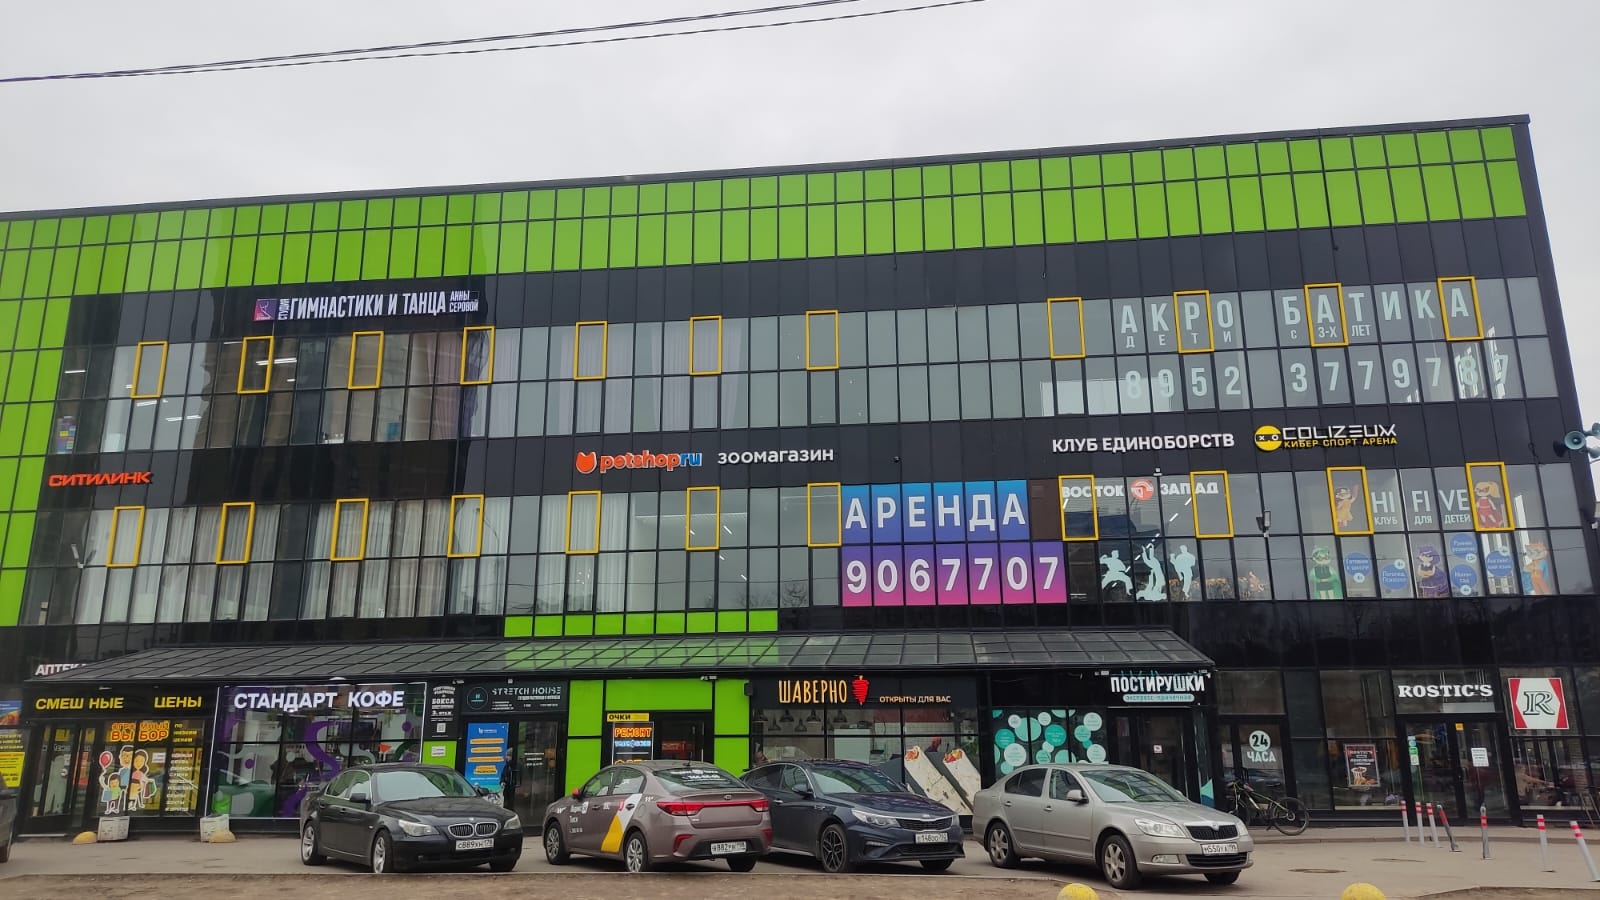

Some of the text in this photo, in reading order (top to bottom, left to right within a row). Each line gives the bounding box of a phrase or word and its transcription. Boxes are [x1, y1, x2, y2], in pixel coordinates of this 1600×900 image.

[450, 290, 470, 301] АННЫ
[289, 291, 446, 320] ГИМНАСТИКИ И ТАНЦА
[449, 299, 479, 312] СЕРОВОЙ
[1121, 287, 1469, 333] АКРО БАТИКА
[1126, 330, 1232, 348] ДЕТИ
[1351, 324, 1371, 337] ЛЕТ
[1125, 366, 1241, 399] 8952
[1052, 433, 1235, 453] КЛУБ ЕДИНОБОРСТВ
[1284, 437, 1397, 448] КИБЕР СПОРТ АРЕНА
[718, 449, 834, 464] зоомагазин
[48, 471, 152, 487] СИТИЛИНК
[1062, 481, 1219, 498] ВОСТОК ЗАПАД
[1371, 490, 1395, 513] HI
[845, 493, 1026, 532] АРЕНДА
[1374, 514, 1471, 525] КЛУБ ДЛЯ ДЕТЕЙ
[846, 556, 1059, 594] 9067707
[35, 663, 87, 676] АПТЕ
[491, 686, 561, 696] STRETCH HOUSE
[778, 679, 848, 704] ШАВЕРНО
[1110, 675, 1205, 693] ПОСТИРУШКИ
[1398, 684, 1493, 698] ROSTIC'S
[154, 696, 202, 709] ЦЕНЫ
[234, 691, 405, 712] СТАНДАРТ КОФЕ
[879, 695, 952, 704] ОТКРЫТЫ ДЛЯ ВАС
[1522, 690, 1555, 716] R
[614, 727, 652, 738] РЕМОНТ
[1251, 734, 1268, 747] 24
[1246, 751, 1276, 763] ЧАСА
